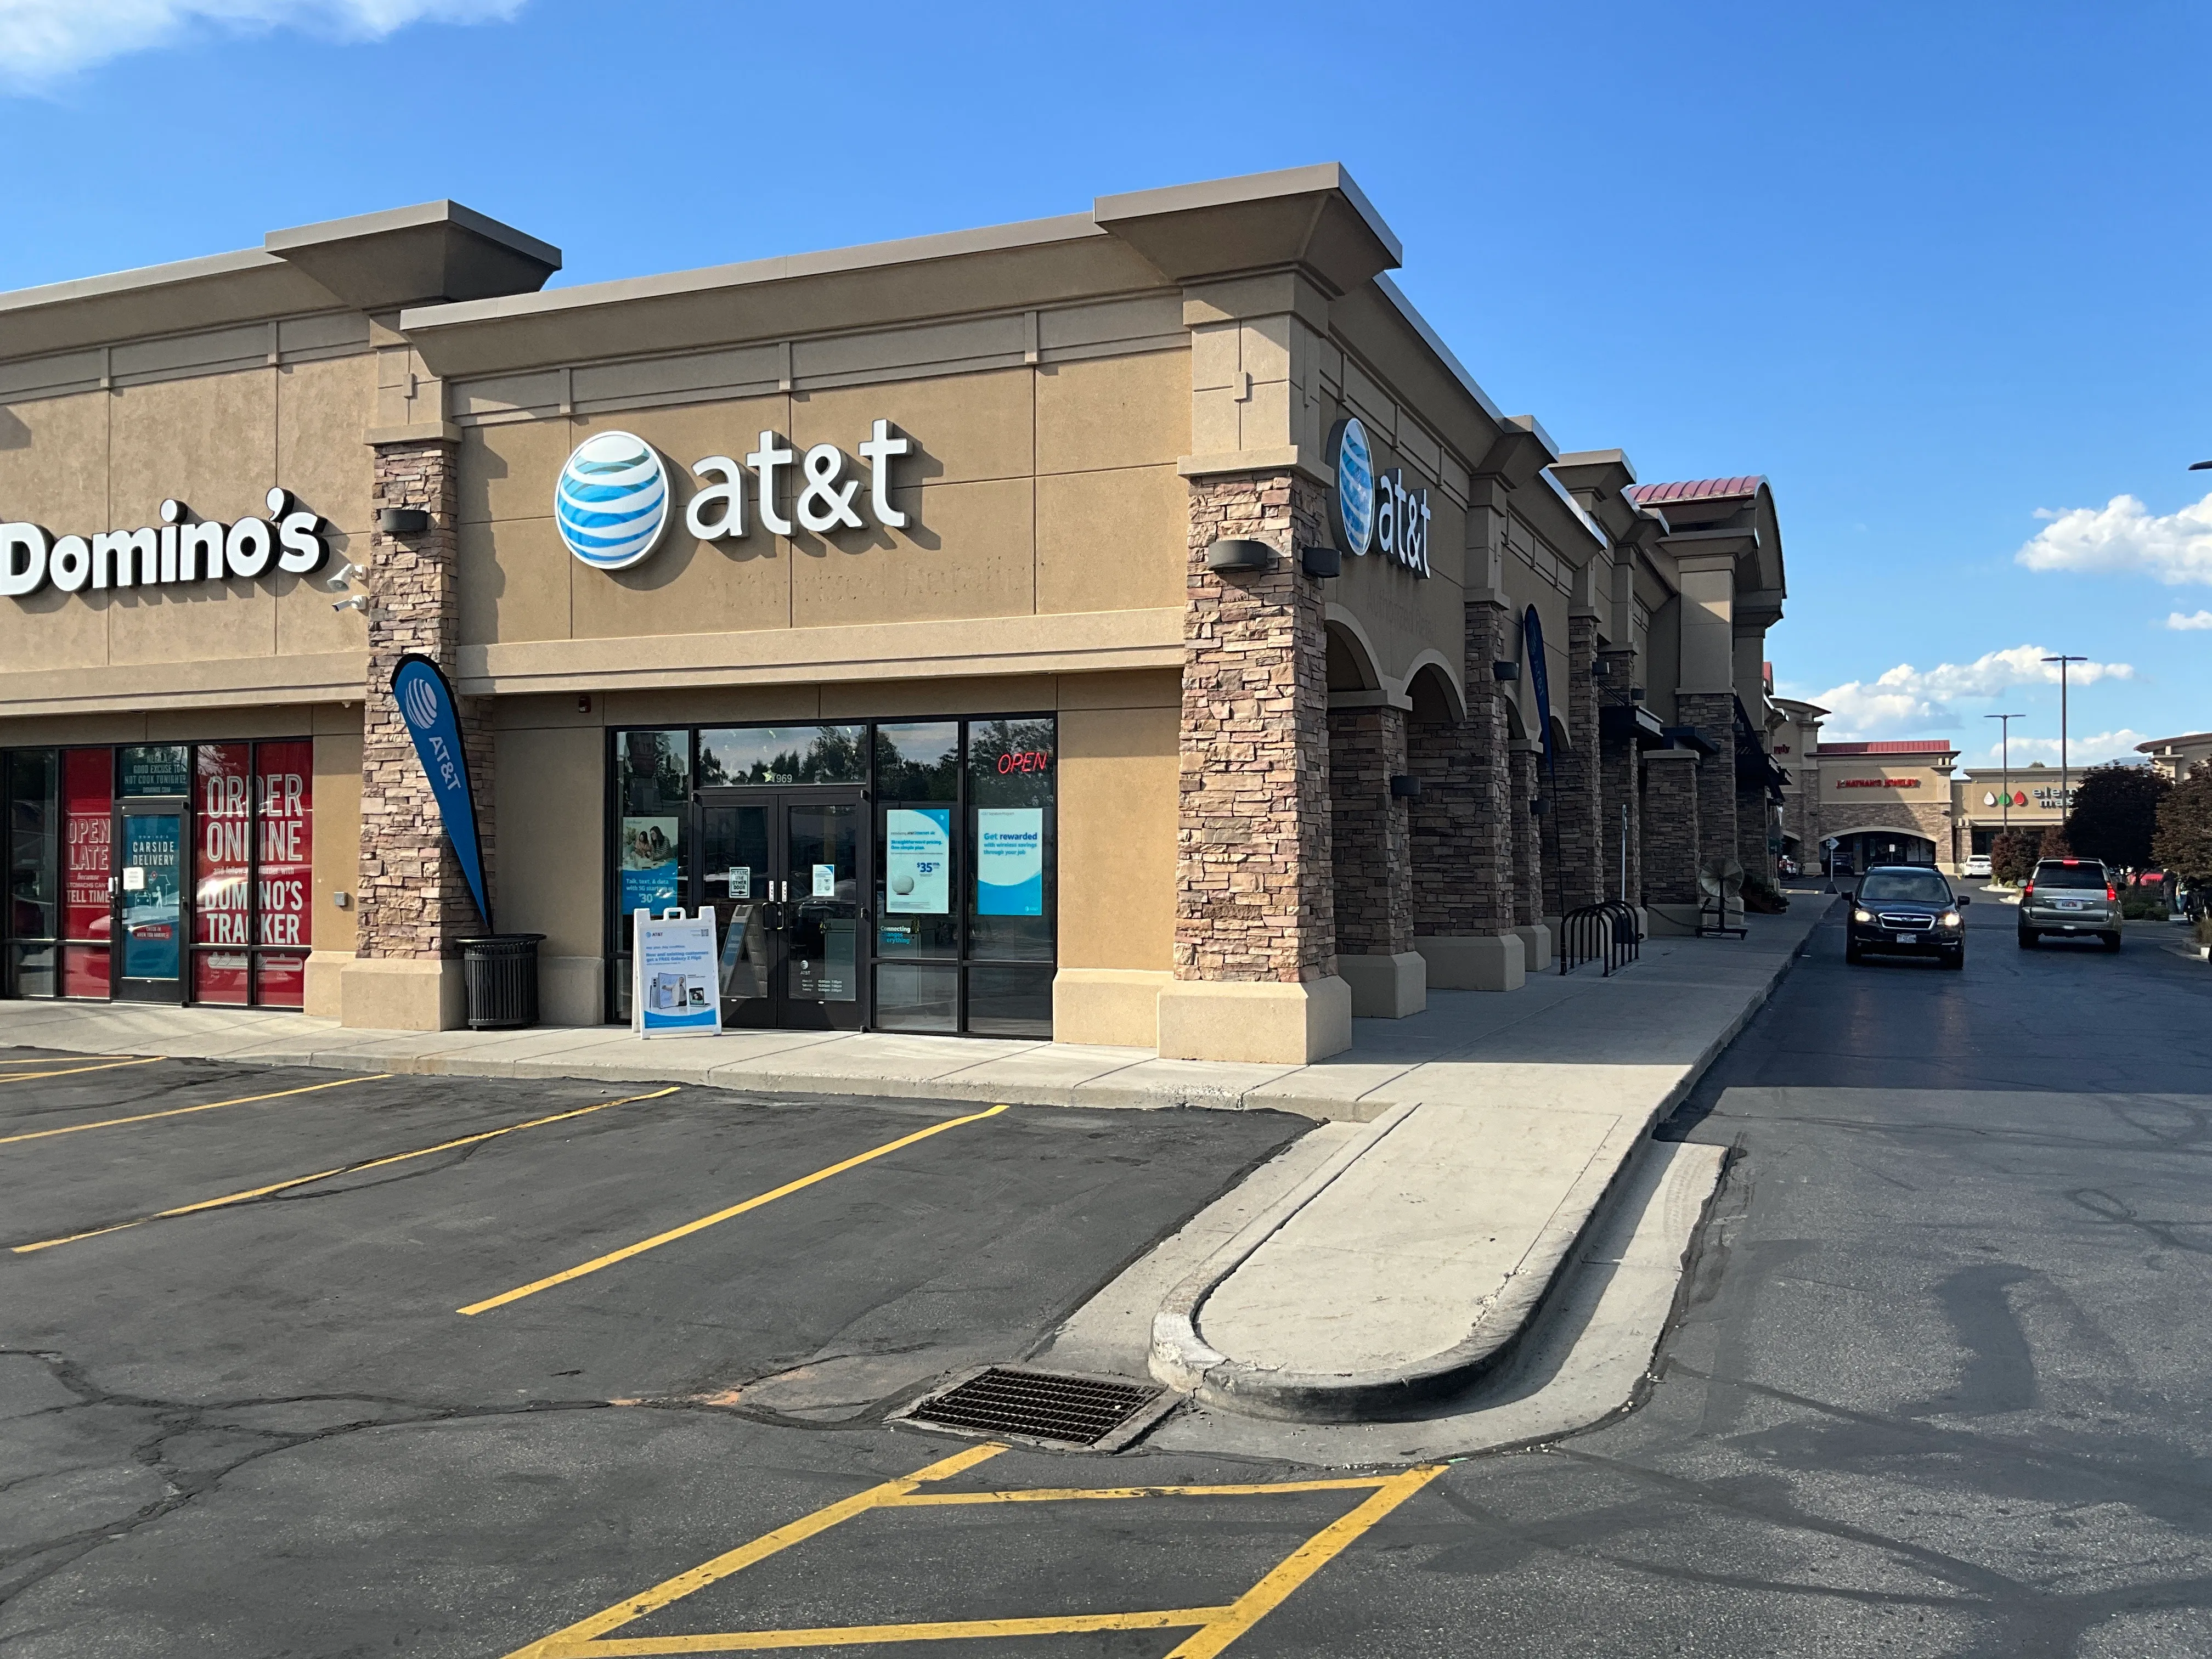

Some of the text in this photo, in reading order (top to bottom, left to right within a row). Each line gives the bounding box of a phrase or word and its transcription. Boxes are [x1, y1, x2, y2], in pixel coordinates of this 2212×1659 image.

[686, 418, 908, 540] at&t
[1379, 468, 1431, 579] at&t
[0, 487, 320, 596] Domino's
[428, 736, 461, 791] AT&T
[997, 752, 1048, 774] OPEN
[207, 774, 303, 819] ORDER
[66, 819, 110, 844] OPEN
[1000, 832, 1037, 840] rewarded
[69, 845, 109, 870] LATE
[133, 842, 174, 853] CARSIDE
[133, 854, 174, 865] DELIVERY
[66, 890, 110, 902] TELL TIME
[205, 880, 303, 911] DOMNO'S
[206, 913, 300, 944] TRAKER
